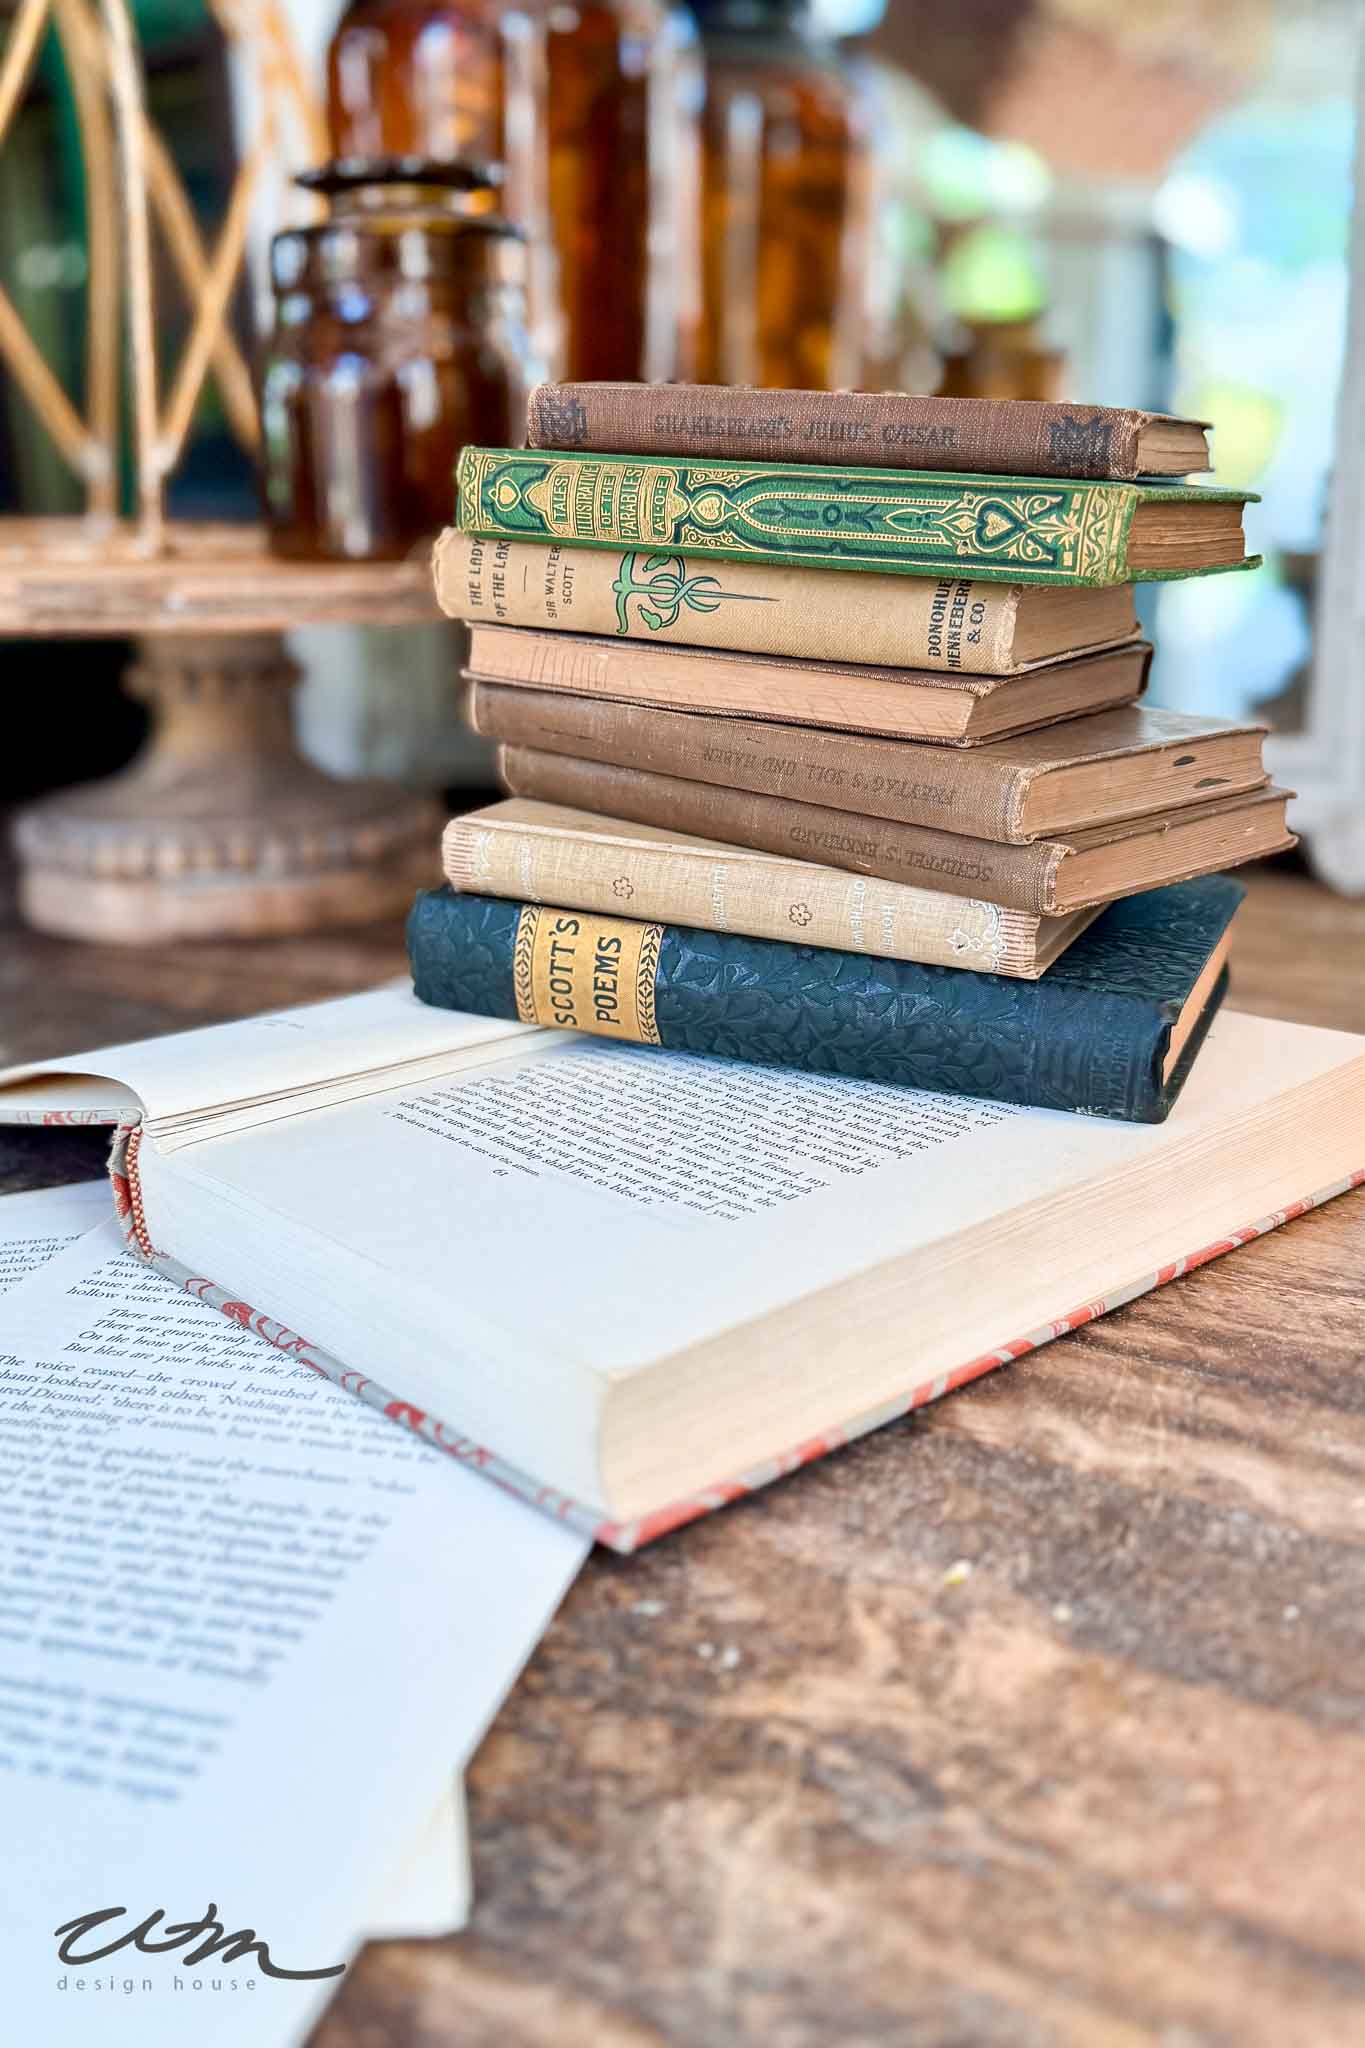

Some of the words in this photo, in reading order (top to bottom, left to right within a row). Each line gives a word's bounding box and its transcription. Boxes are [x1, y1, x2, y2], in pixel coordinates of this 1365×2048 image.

[553, 477, 569, 520] TALES
[575, 464, 599, 537] ILLUSTRATIVE
[601, 477, 615, 502] THE
[620, 468, 644, 538] PARABLES
[600, 508, 613, 525] OF
[469, 538, 486, 575] LADY
[494, 540, 513, 568] LAK
[545, 544, 561, 595] WALTER
[469, 581, 483, 607] THE
[492, 576, 506, 601] THE
[562, 566, 576, 605] SCOTT
[495, 604, 507, 617] OF
[545, 601, 558, 619] SIR
[928, 577, 953, 657] DONOHUE
[947, 579, 974, 668] HENNEBERR
[967, 629, 982, 644] &
[548, 917, 580, 1026] SCOTT'S
[593, 936, 622, 1025] POEMS
